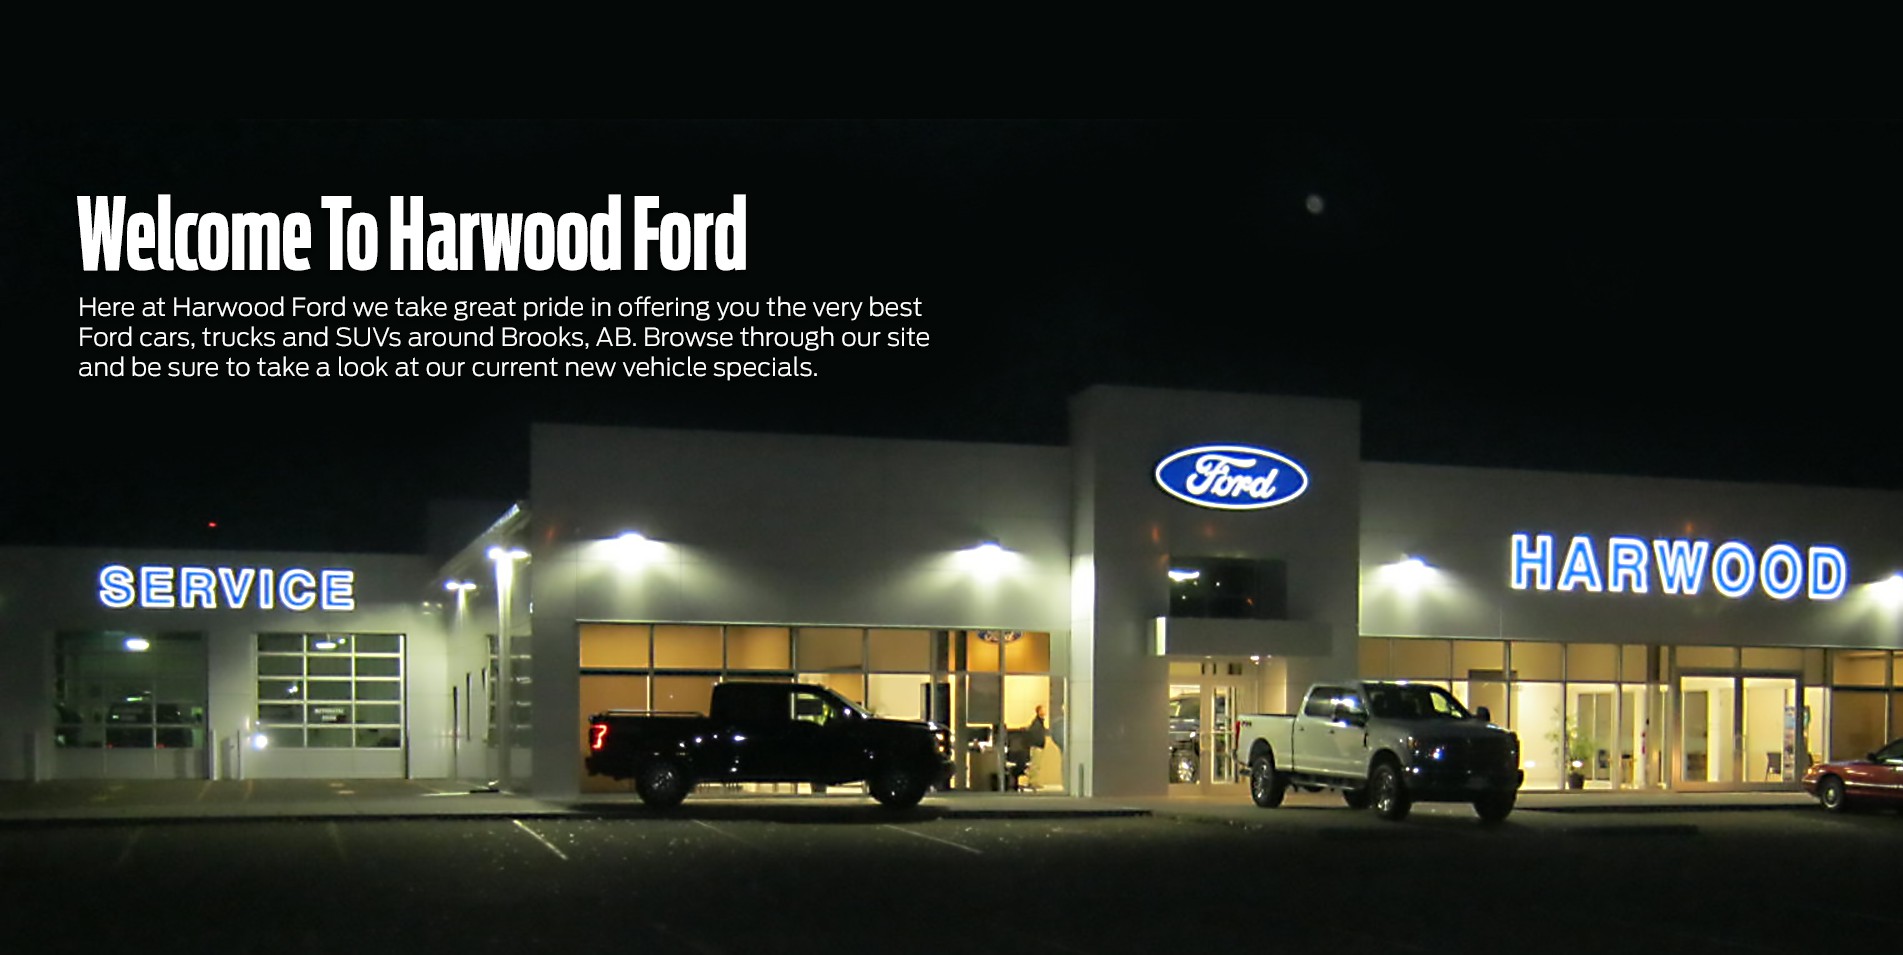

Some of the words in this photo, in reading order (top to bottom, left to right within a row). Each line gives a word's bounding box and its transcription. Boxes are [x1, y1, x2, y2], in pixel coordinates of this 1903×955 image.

[1186, 454, 1279, 499] Ford
[99, 565, 355, 610] SERVICE
[1510, 533, 1848, 601] HARWOOD
